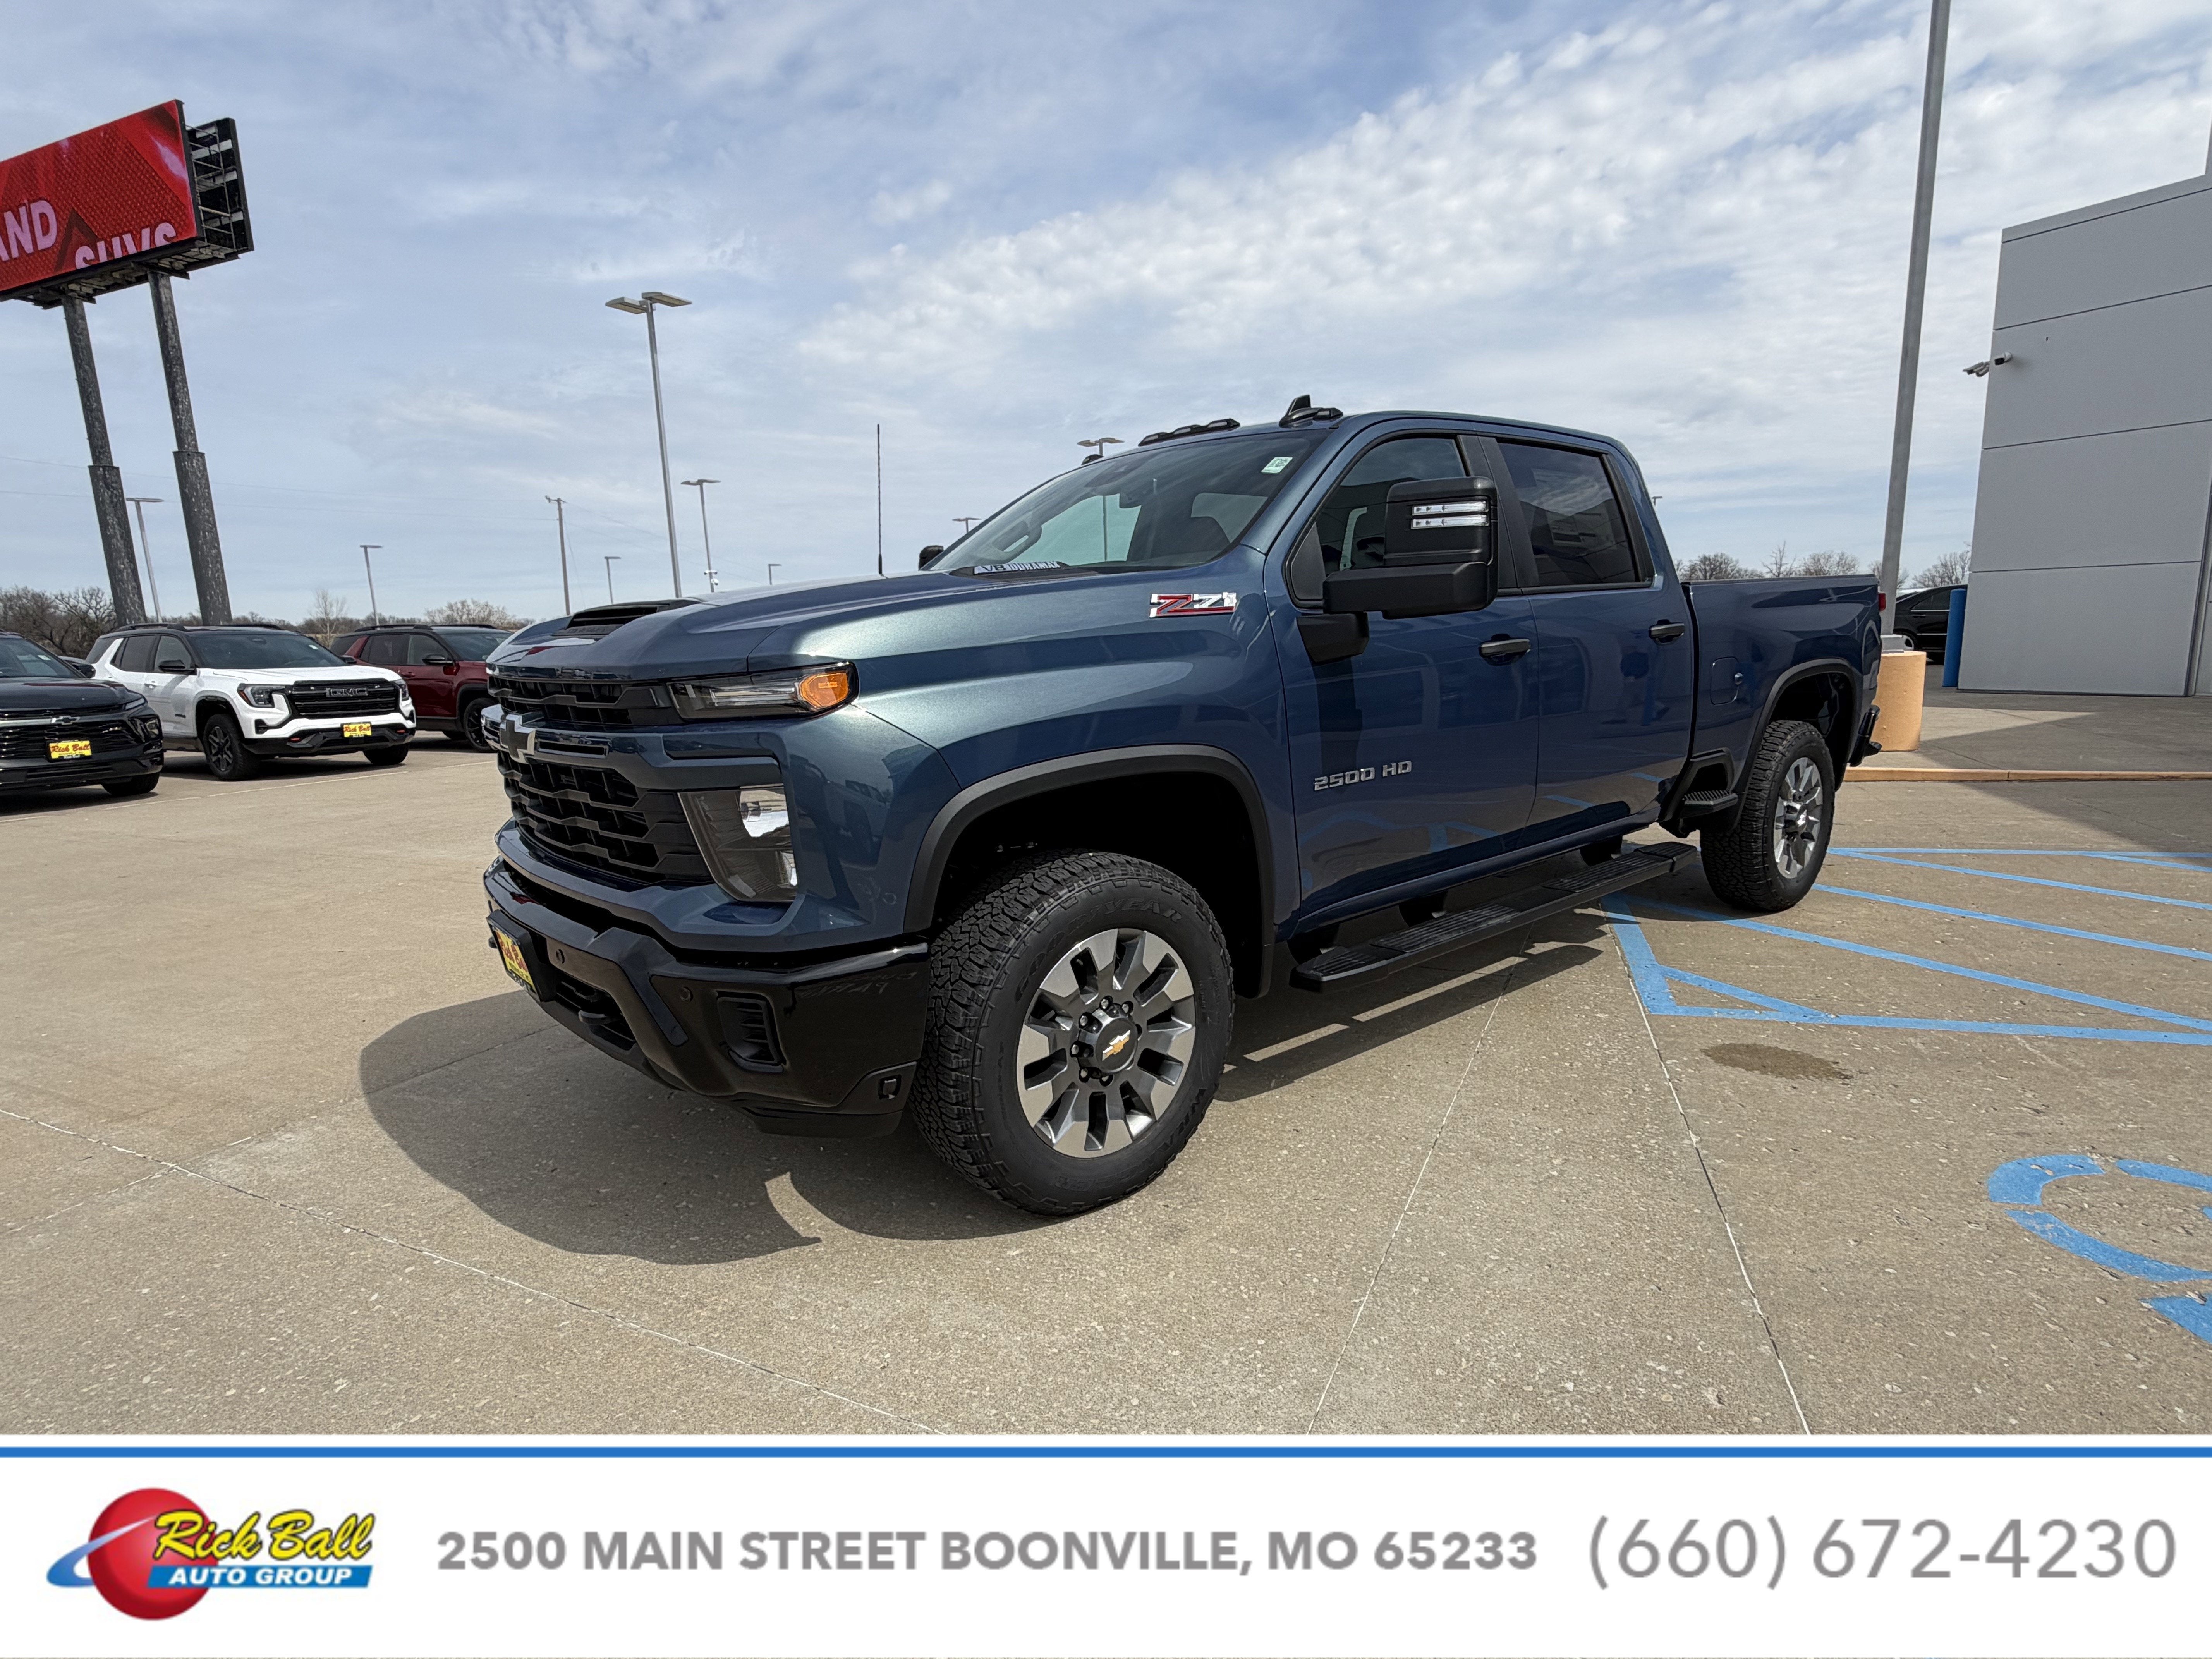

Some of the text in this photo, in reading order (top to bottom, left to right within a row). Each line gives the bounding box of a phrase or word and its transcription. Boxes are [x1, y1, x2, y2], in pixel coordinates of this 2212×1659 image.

[1008, 561, 1062, 571] DURAMAX
[1149, 592, 1237, 618] Z71
[1314, 760, 1412, 791] 2500 HD
